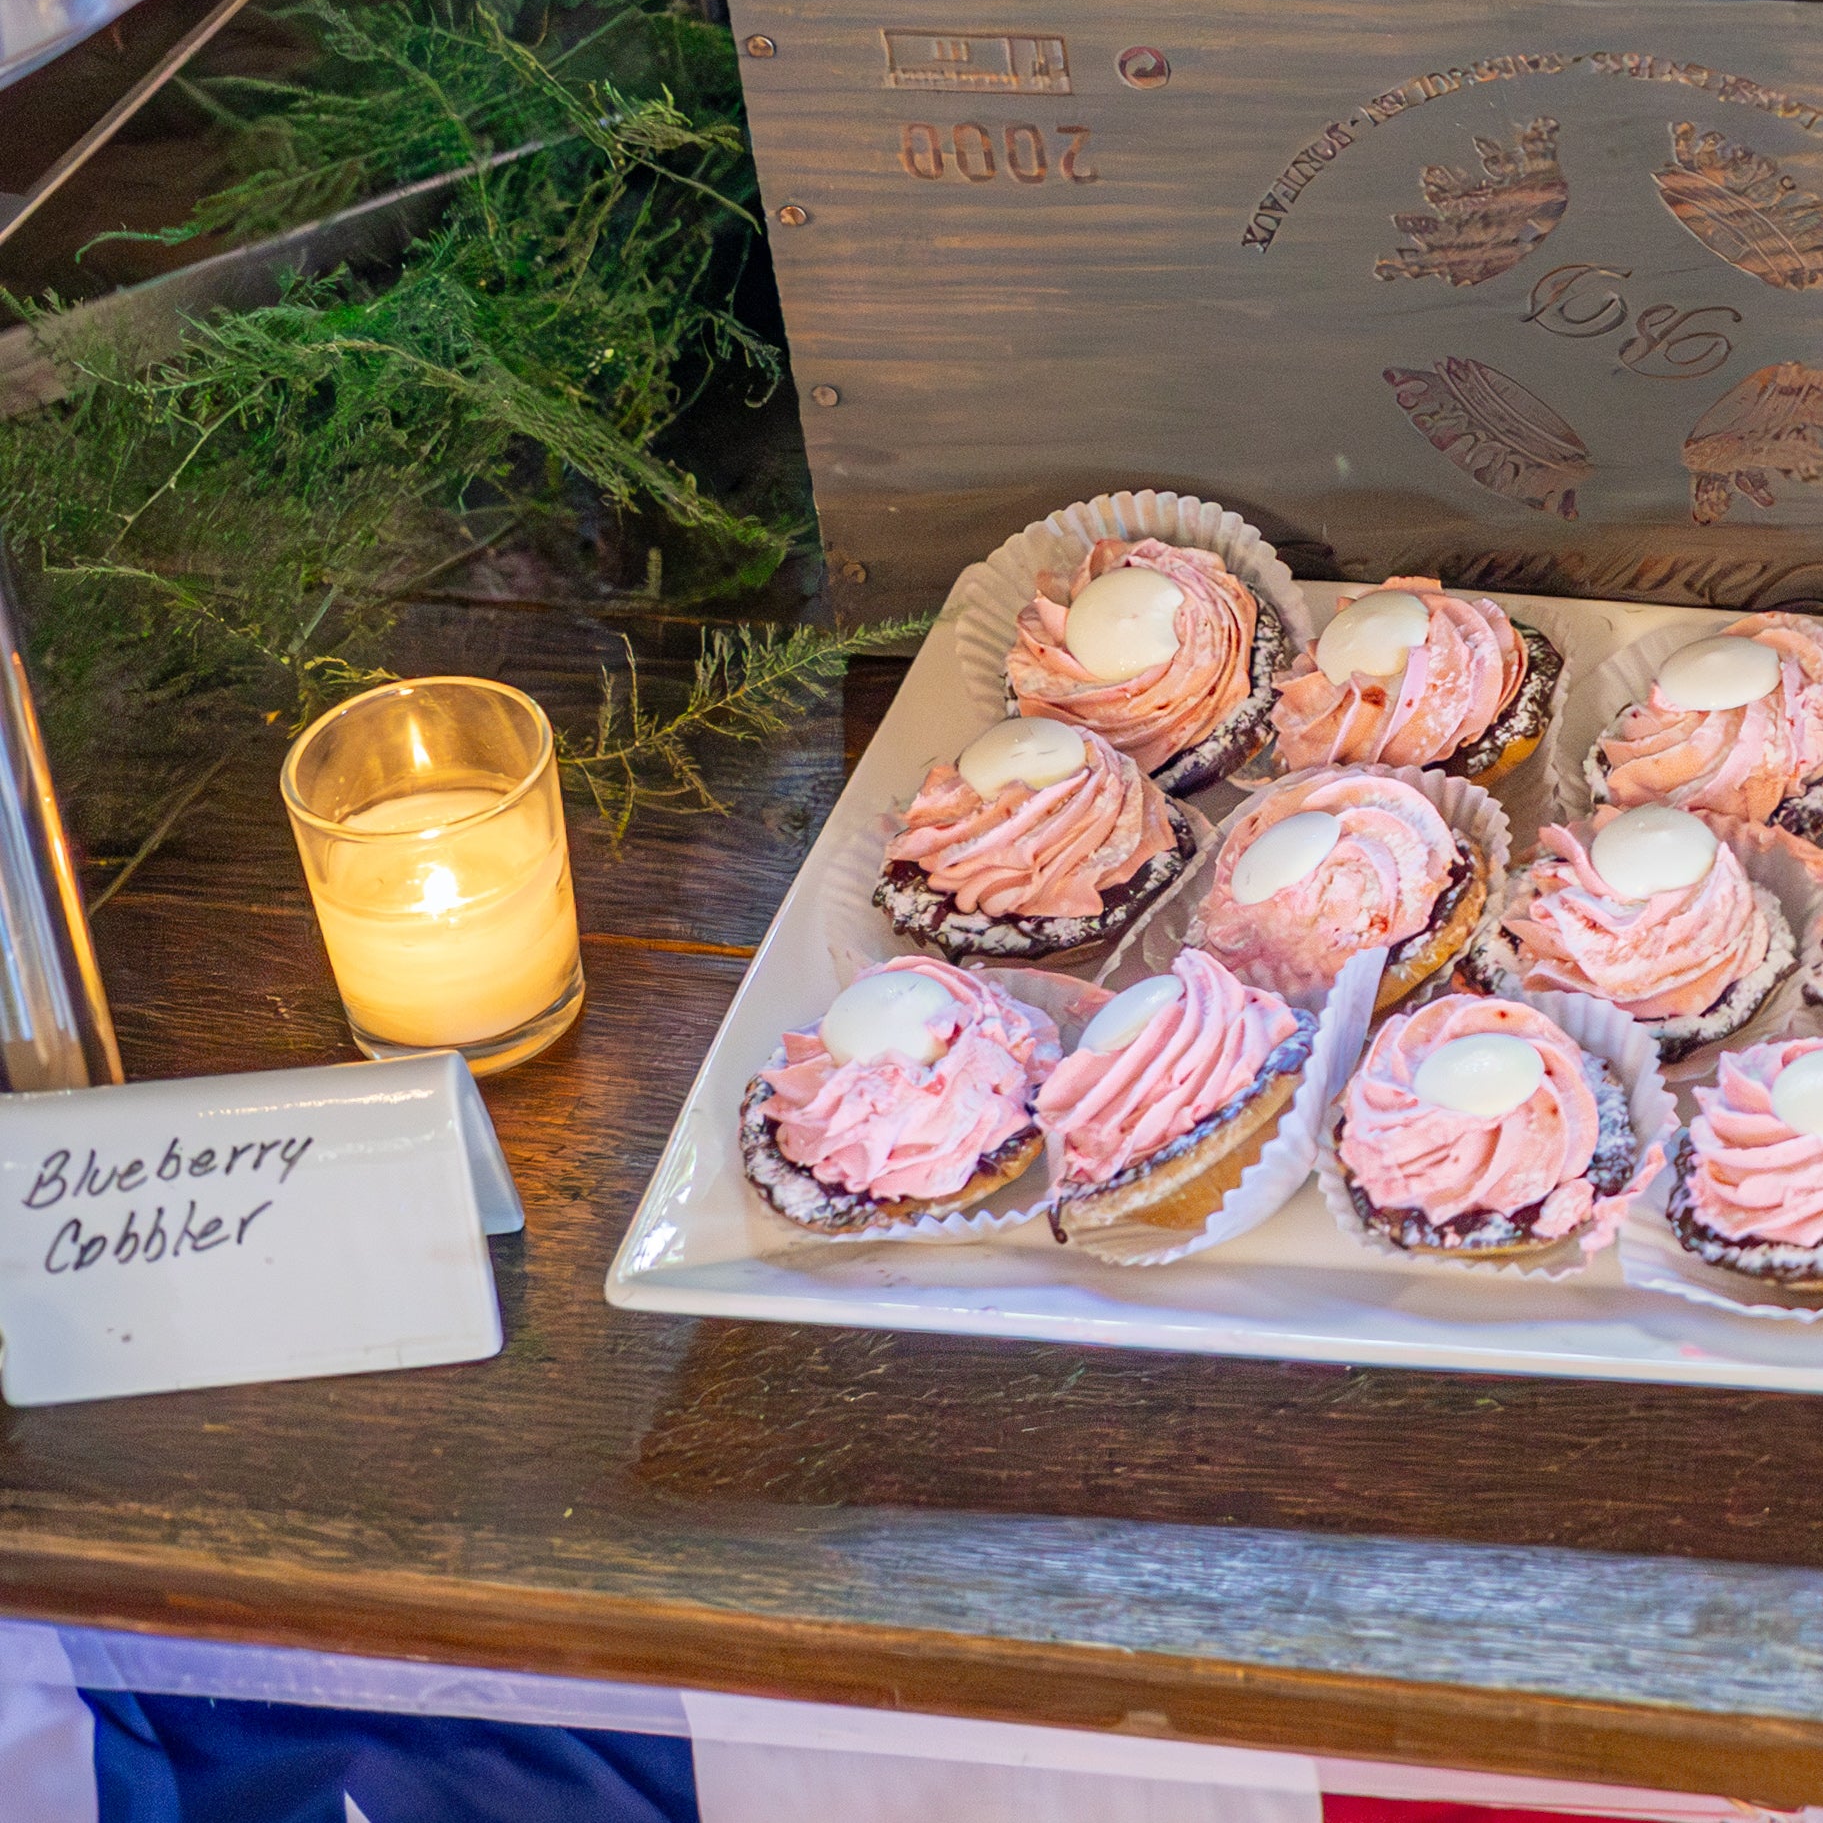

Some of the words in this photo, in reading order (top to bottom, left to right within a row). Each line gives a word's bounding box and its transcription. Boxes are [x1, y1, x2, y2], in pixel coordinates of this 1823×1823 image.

[902, 123, 1100, 183] 2000
[22, 1136, 315, 1210] Blueberry
[44, 1200, 273, 1276] Cobbler
